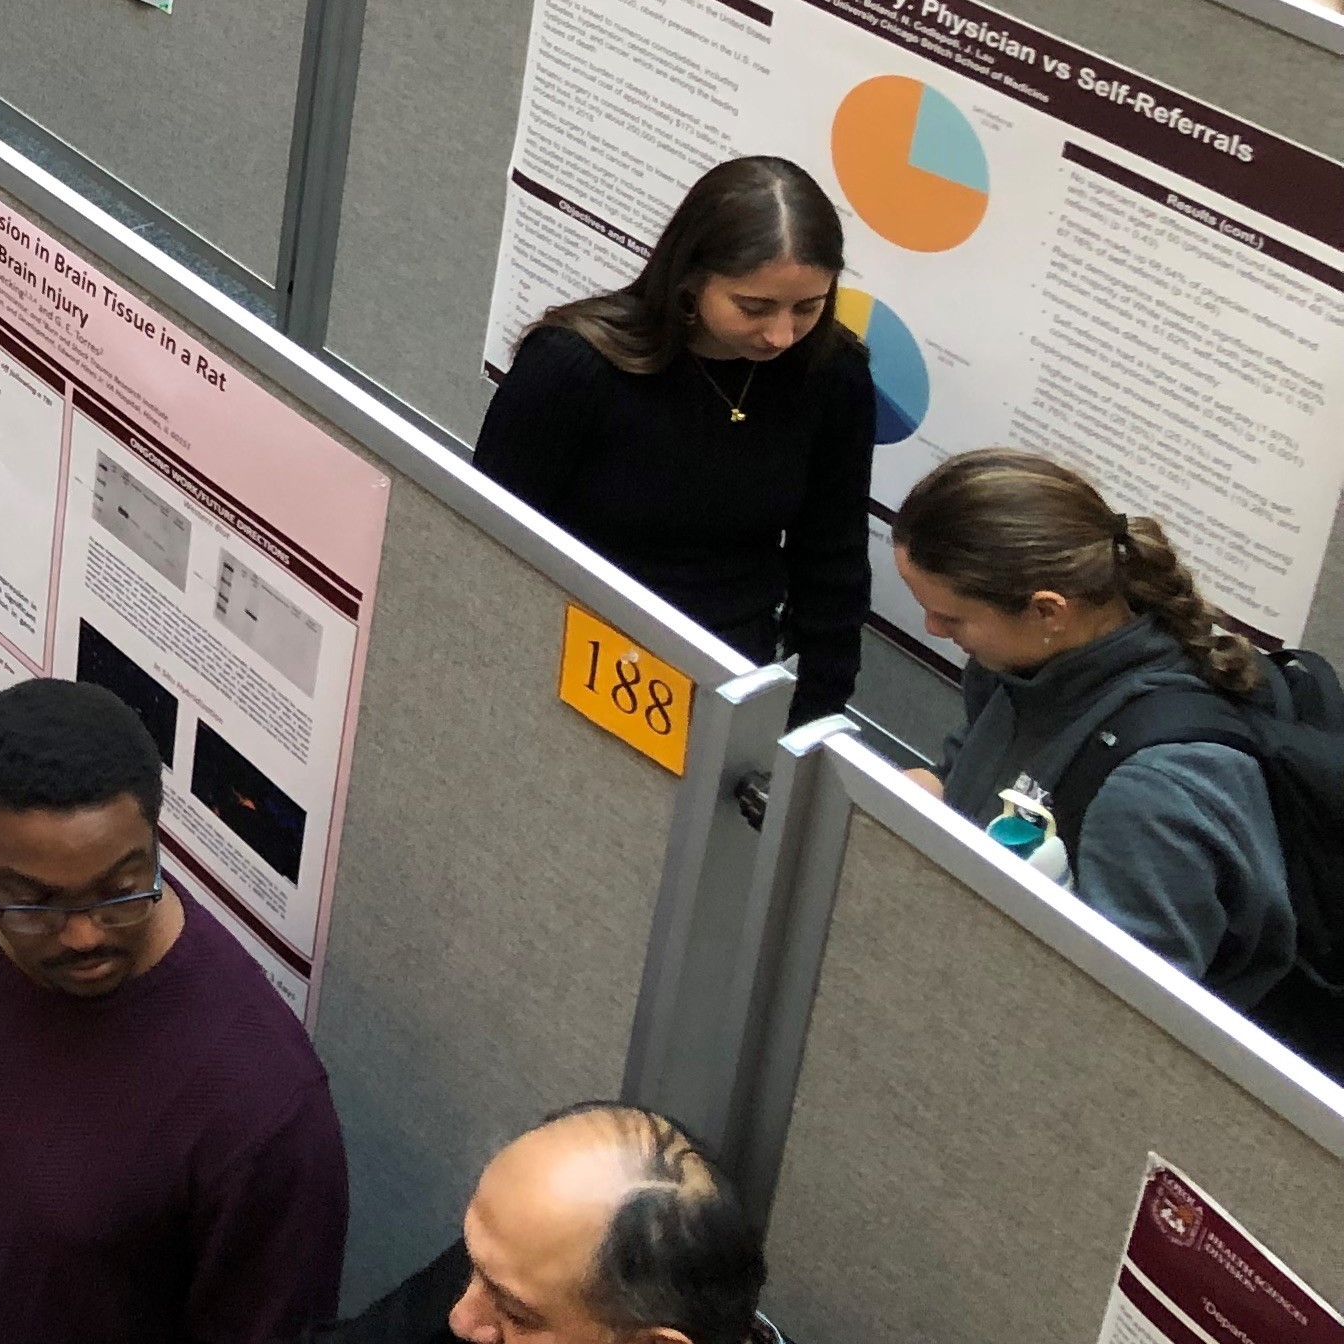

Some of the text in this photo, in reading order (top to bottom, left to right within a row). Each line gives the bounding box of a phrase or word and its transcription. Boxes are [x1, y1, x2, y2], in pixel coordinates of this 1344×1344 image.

[880, 19, 918, 43] Chicago
[920, 37, 952, 58] Stritch
[955, 53, 989, 75] School
[991, 71, 1002, 80] of
[1004, 75, 1049, 102] Medicine
[1043, 56, 1071, 79] vs
[1077, 68, 1253, 161] Self-Referrals
[558, 199, 625, 244] Objectives and
[1166, 193, 1263, 250] Results (cont.)
[34, 237, 49, 262] in
[54, 252, 96, 297] Brain
[103, 285, 155, 339] Tissue
[161, 327, 176, 355] in
[180, 348, 190, 365] a
[196, 355, 226, 392] Rat
[41, 277, 88, 328] Injury
[130, 437, 289, 564] ONGOING WORK/FUTURE DIRECTIONS
[586, 640, 673, 736] 188
